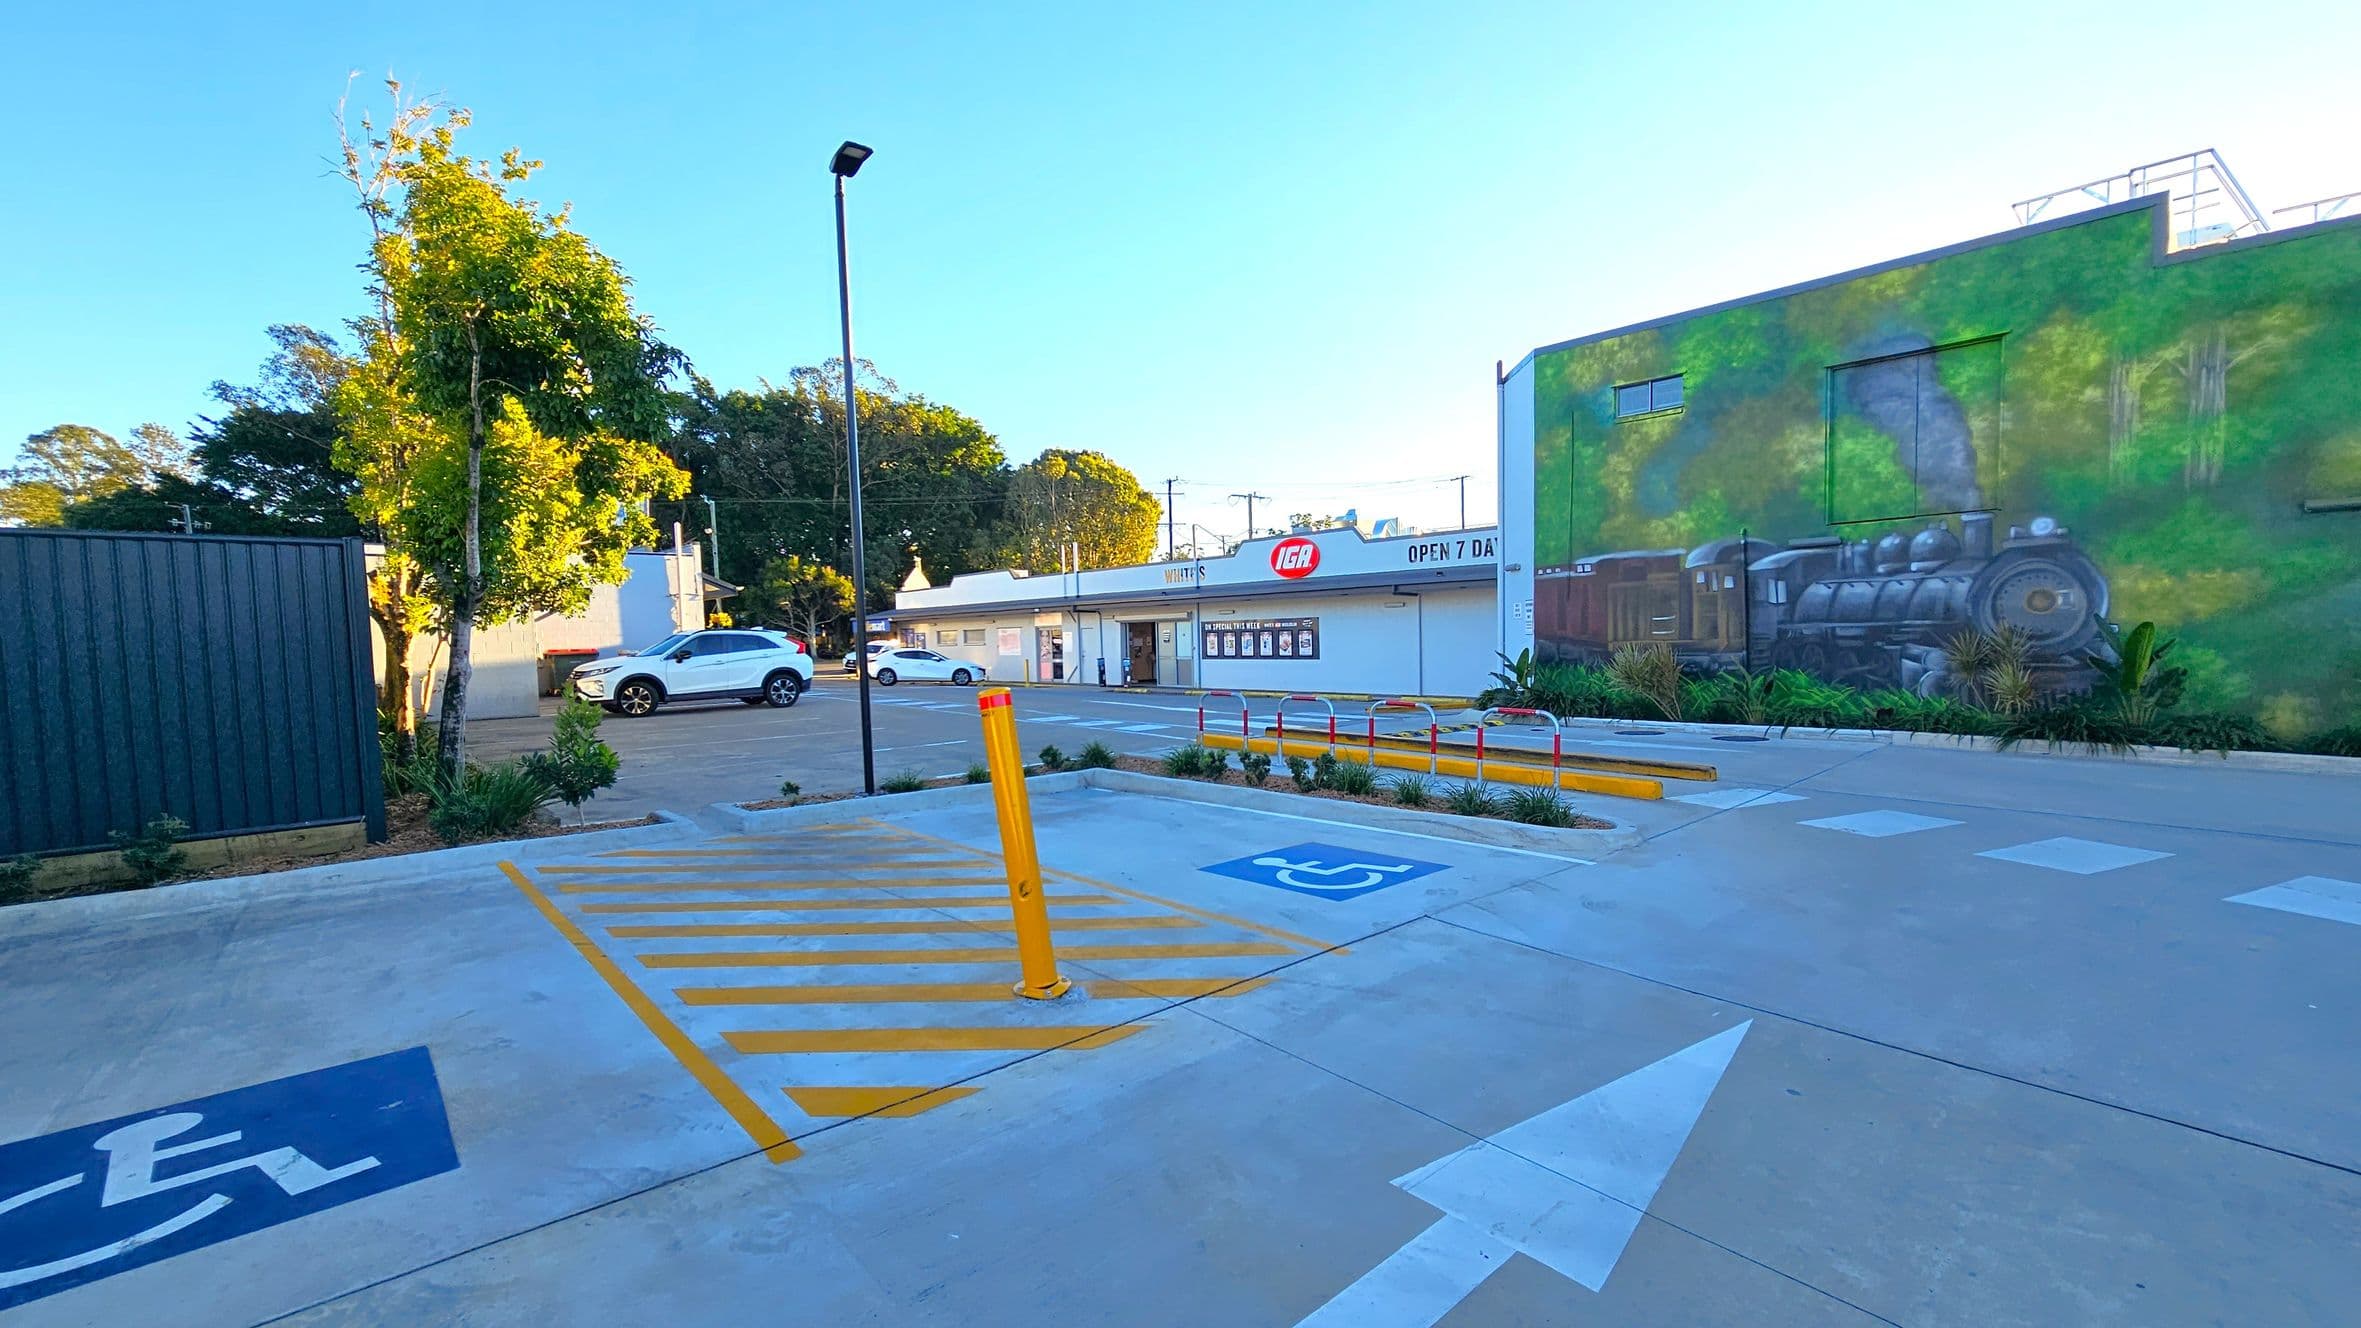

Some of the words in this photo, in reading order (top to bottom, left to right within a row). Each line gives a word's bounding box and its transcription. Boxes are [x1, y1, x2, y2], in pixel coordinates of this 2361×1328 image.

[1275, 544, 1313, 570] IGA
[1408, 542, 1450, 563] OPEN
[1456, 540, 1465, 559] 7
[1164, 565, 1206, 584] WHITES
[1212, 623, 1232, 631] SPECIAL
[1233, 622, 1245, 630] THIS
[1246, 622, 1260, 630] WEEK
